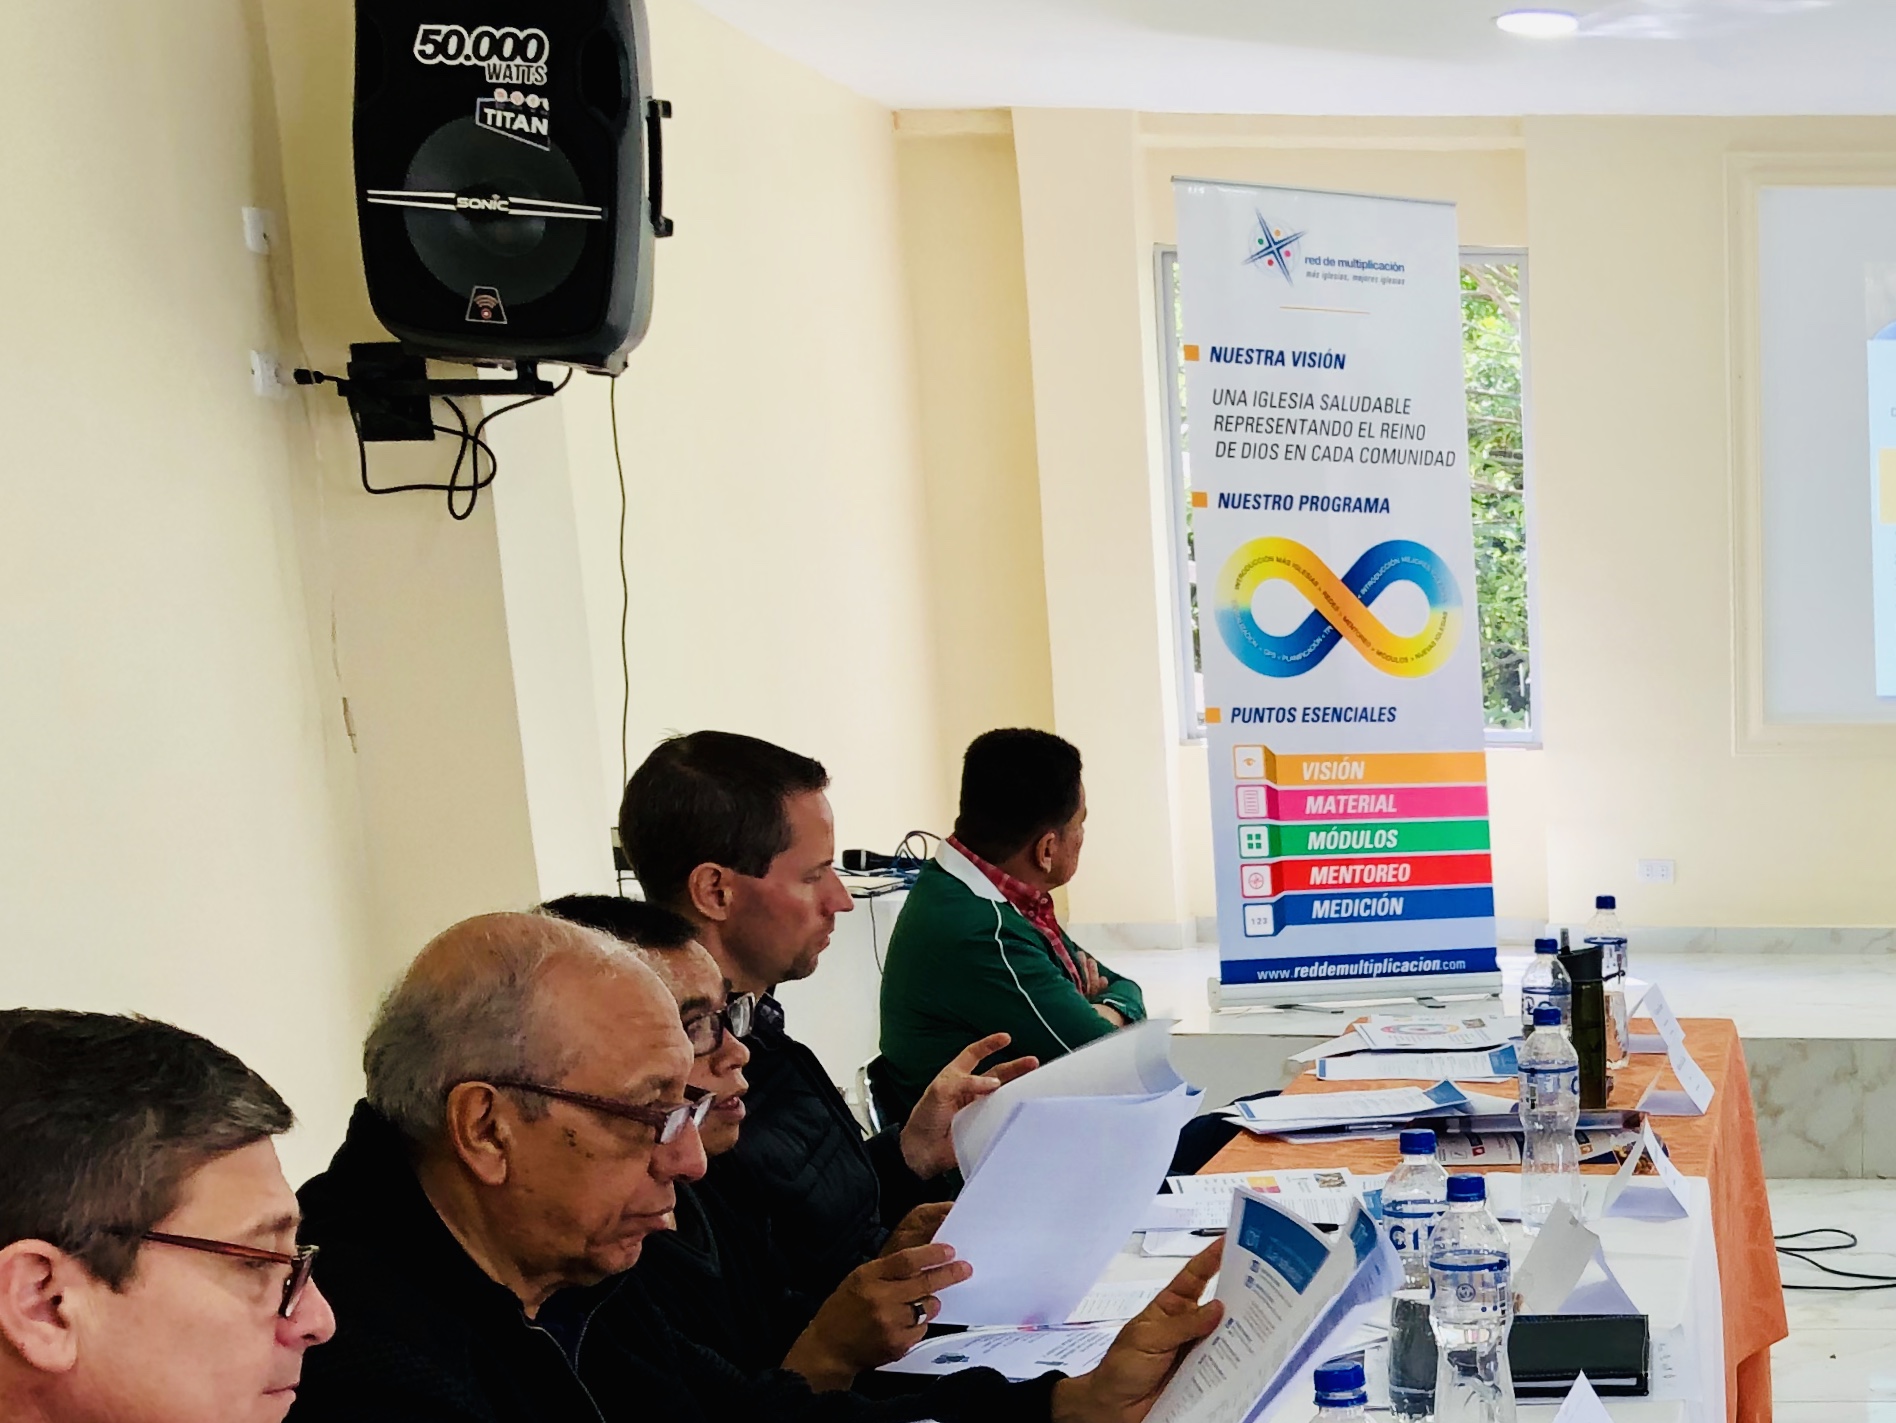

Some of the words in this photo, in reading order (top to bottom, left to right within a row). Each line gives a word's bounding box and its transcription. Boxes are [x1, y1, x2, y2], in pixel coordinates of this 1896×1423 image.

[414, 24, 549, 64] 50.000
[485, 62, 547, 85] WATTS
[484, 107, 548, 136] TITAN
[1305, 255, 1321, 267] red
[1323, 257, 1335, 267] de
[1337, 258, 1405, 273] multiplicación
[1210, 346, 1285, 367] NUESTRA
[1292, 348, 1346, 370] VISIÓN
[1212, 389, 1248, 407] UNA
[1252, 390, 1315, 411] IGLESIA
[1320, 393, 1411, 415] SALUDABLE
[1213, 415, 1353, 437] REPRESENTANDO
[1358, 420, 1376, 438] EL
[1380, 422, 1426, 441] REINO
[1215, 441, 1236, 458] DE
[1241, 443, 1279, 460] DIOS
[1284, 444, 1306, 461] EN
[1311, 445, 1354, 463] CADA
[1359, 447, 1456, 468] COMUNIDAD
[1218, 492, 1294, 511] NUESTRO
[1299, 494, 1390, 514] PROGRAMA
[1231, 707, 1297, 723] PUNTOS
[1301, 706, 1397, 723] ESENCIALES
[1302, 756, 1365, 780] VISIÓN
[1305, 794, 1397, 814] MATERIAL
[1308, 826, 1398, 850] MÓDULOS
[1309, 863, 1410, 885] MENTOREO
[1312, 893, 1404, 919] MEDICIÓN
[1257, 957, 1466, 981] www.reddemultiplicacion.com
